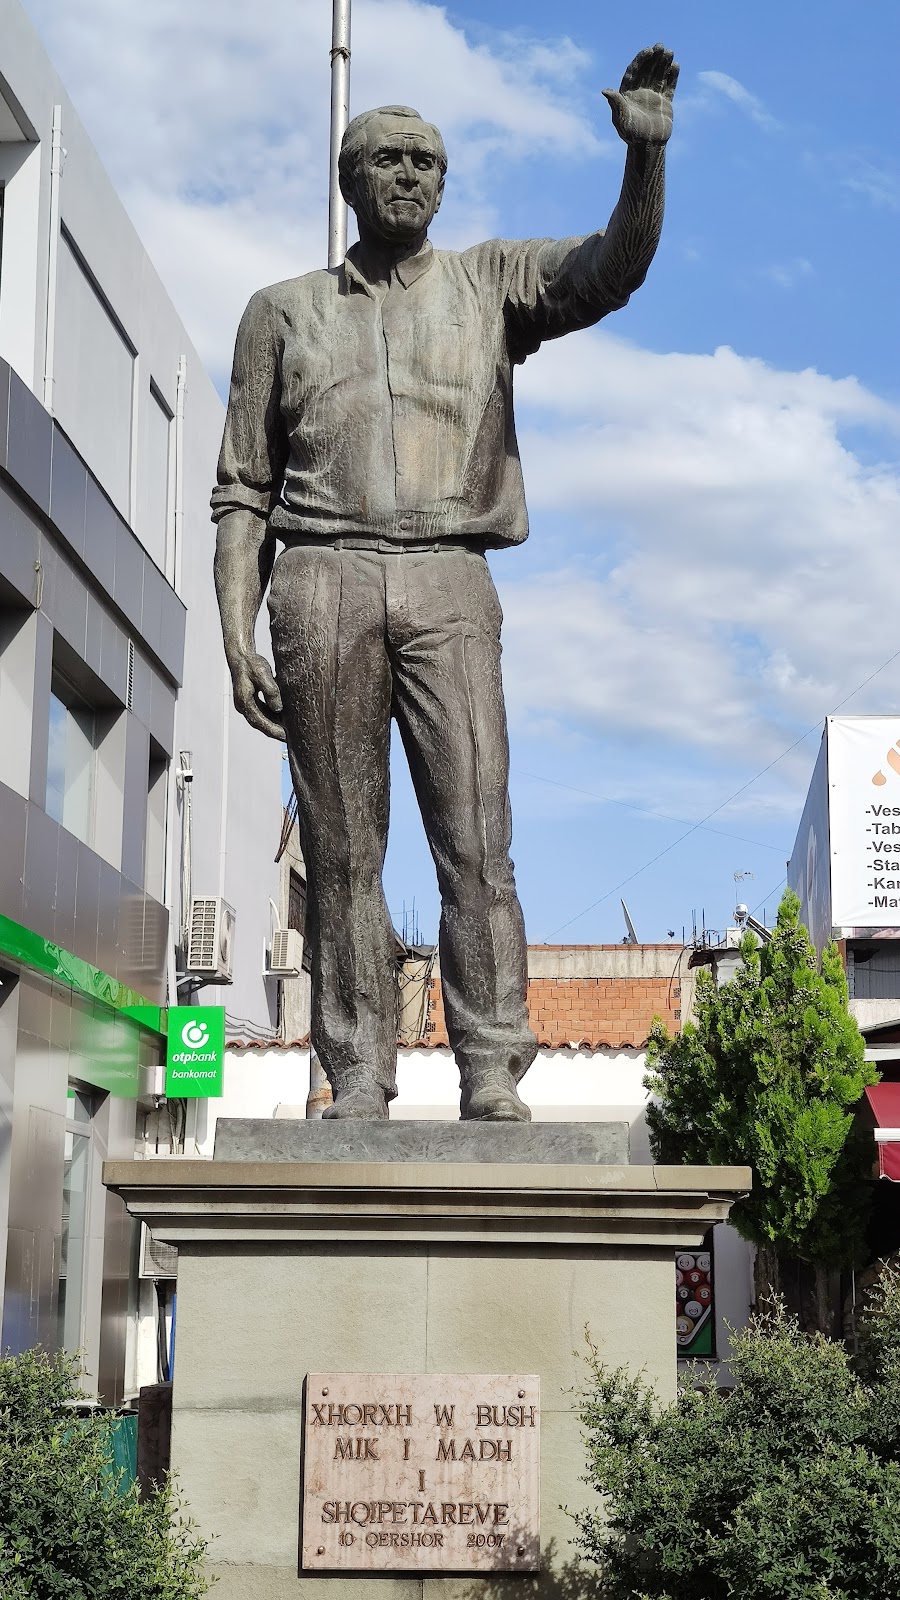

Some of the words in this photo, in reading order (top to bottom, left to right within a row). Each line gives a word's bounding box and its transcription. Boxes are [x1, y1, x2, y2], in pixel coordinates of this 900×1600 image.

[172, 1051, 217, 1065] otpbank
[172, 1069, 217, 1079] bankomat
[310, 1403, 412, 1426] XHORXH
[434, 1404, 455, 1426] W
[476, 1404, 536, 1427] BUSH
[333, 1437, 379, 1460] MIK
[402, 1438, 410, 1460] I
[436, 1439, 513, 1461] MADH
[418, 1469, 425, 1491] I
[321, 1501, 510, 1527] SHQIPETAREVE
[339, 1532, 354, 1547] 10
[366, 1532, 444, 1548] QERSHOR
[466, 1533, 506, 1548] 2007
